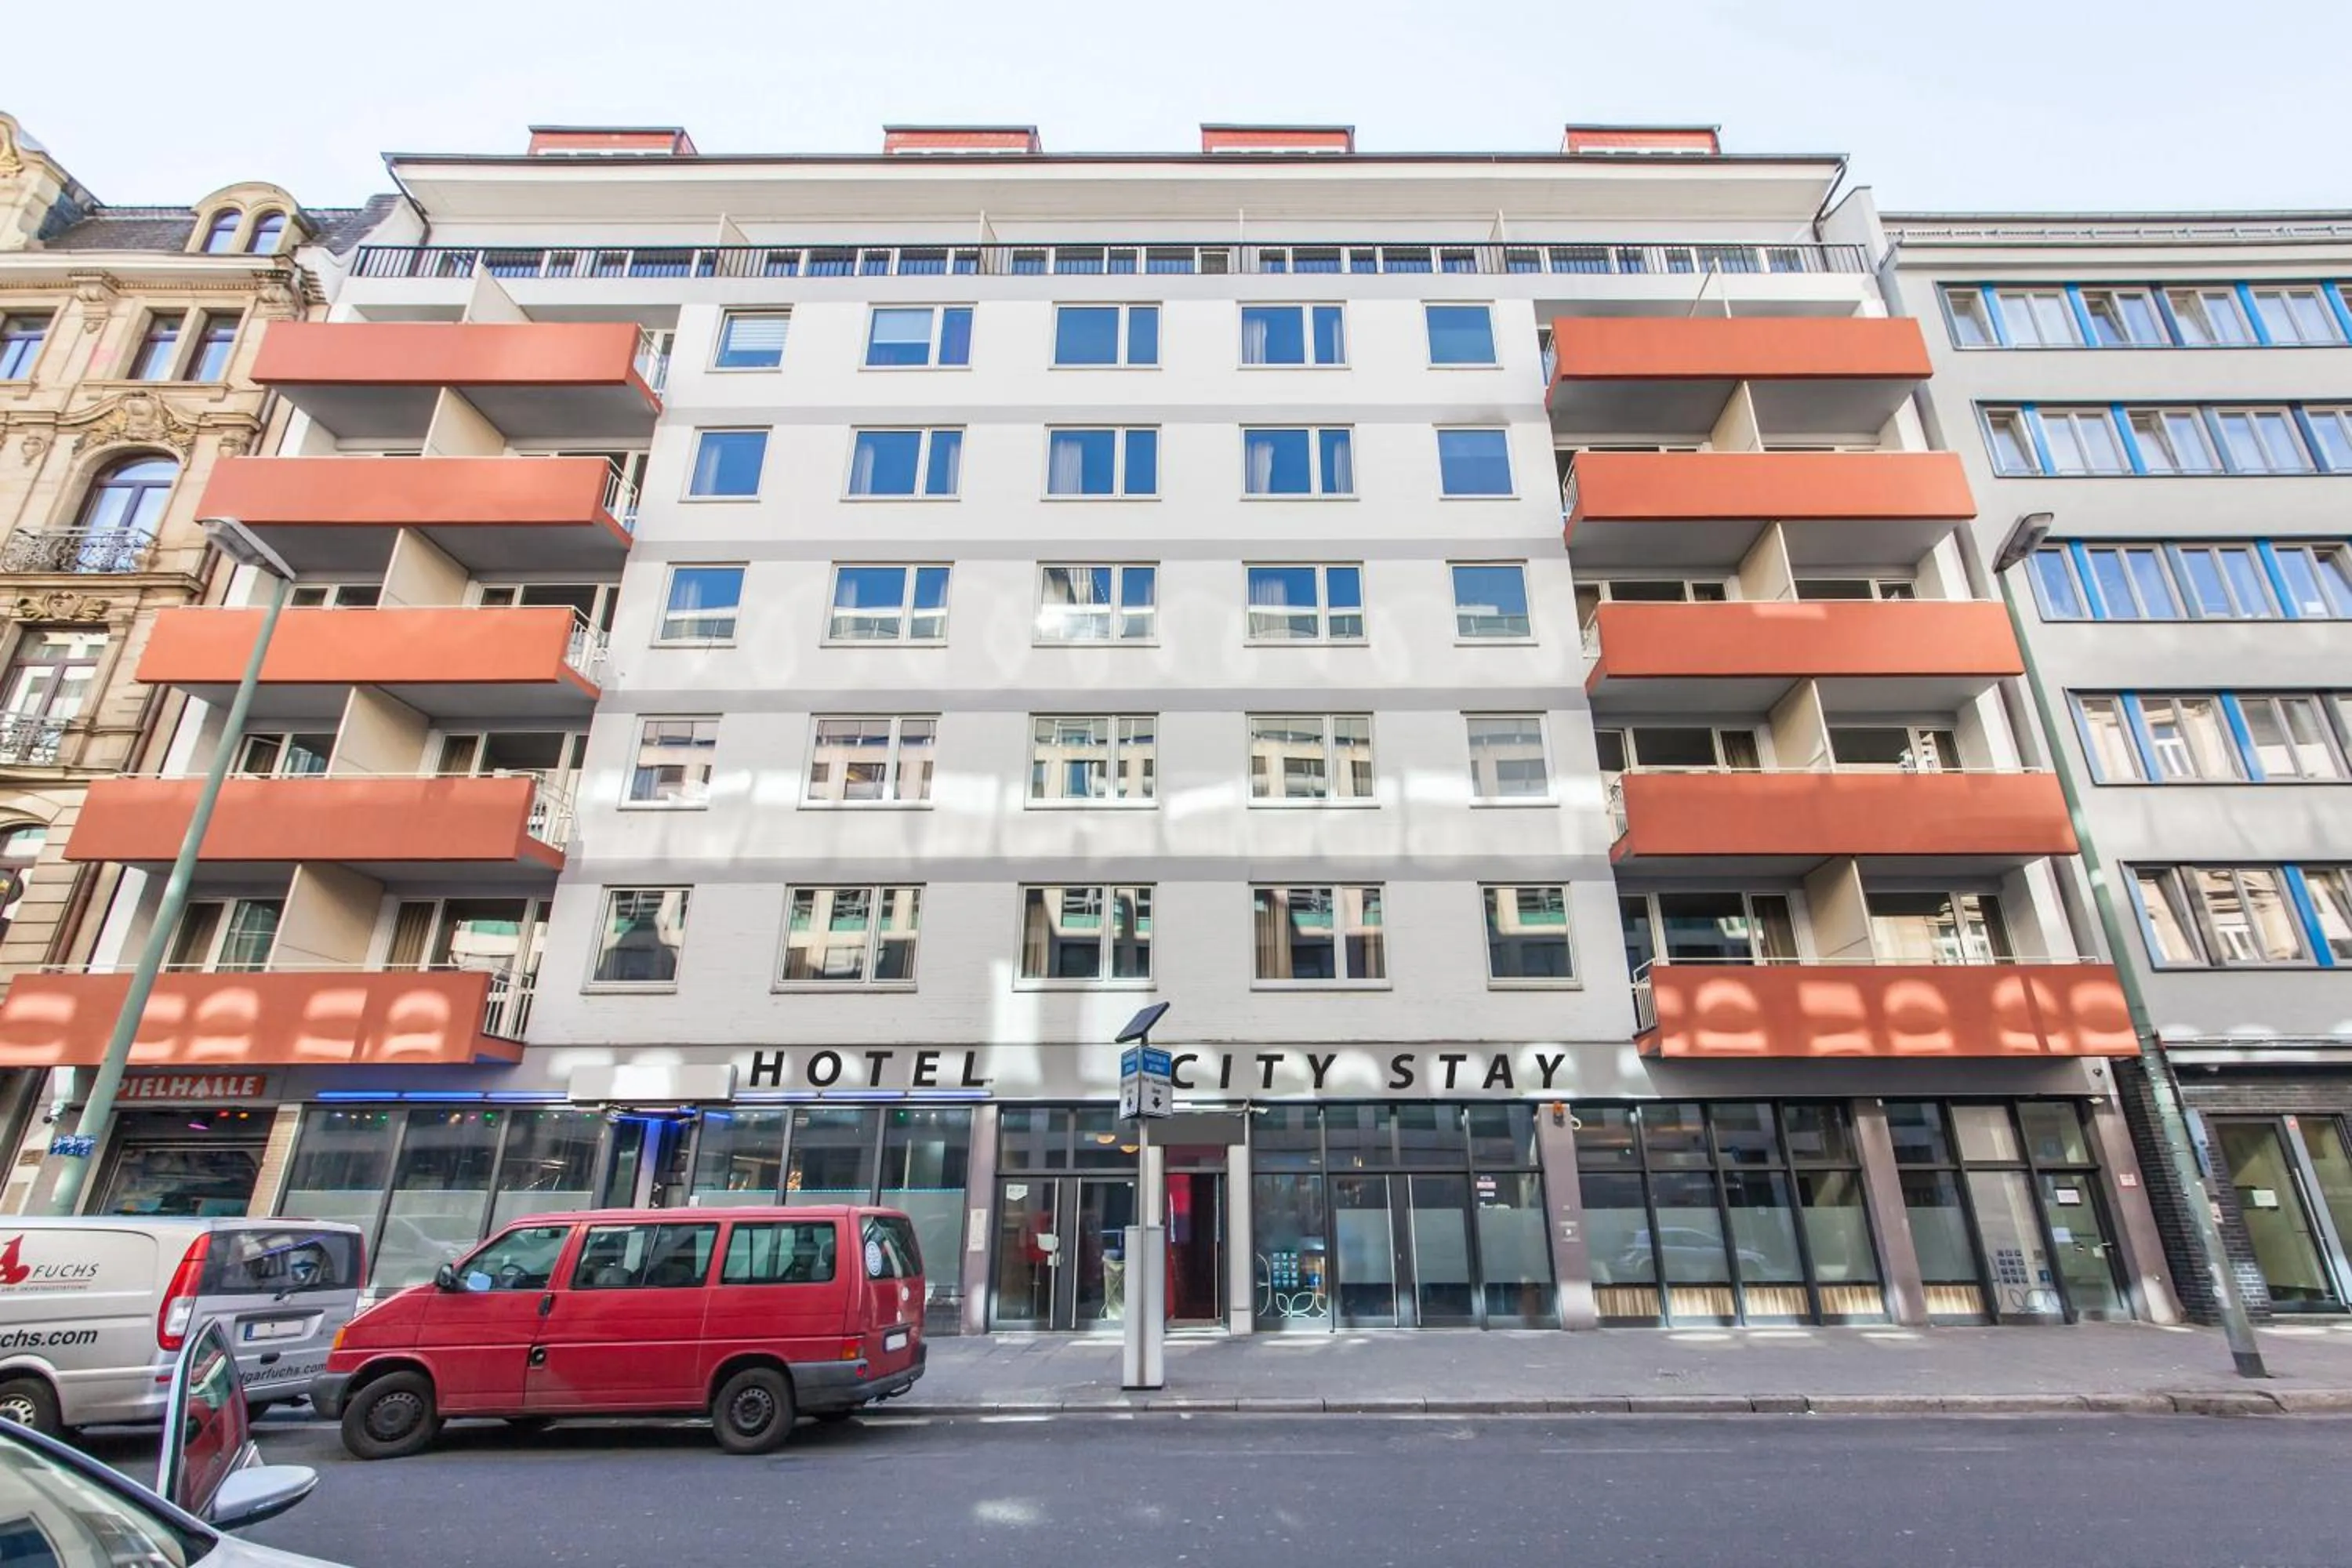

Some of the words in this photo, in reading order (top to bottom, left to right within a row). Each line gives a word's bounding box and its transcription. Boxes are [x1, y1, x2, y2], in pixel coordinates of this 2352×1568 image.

[750, 1051, 985, 1087] HOTEL
[1171, 1054, 1335, 1089] CITY
[1389, 1054, 1565, 1089] STAY
[115, 1076, 258, 1097] PIELHALLE
[32, 1263, 100, 1278] FUCHS
[0, 1330, 98, 1347] chs.com
